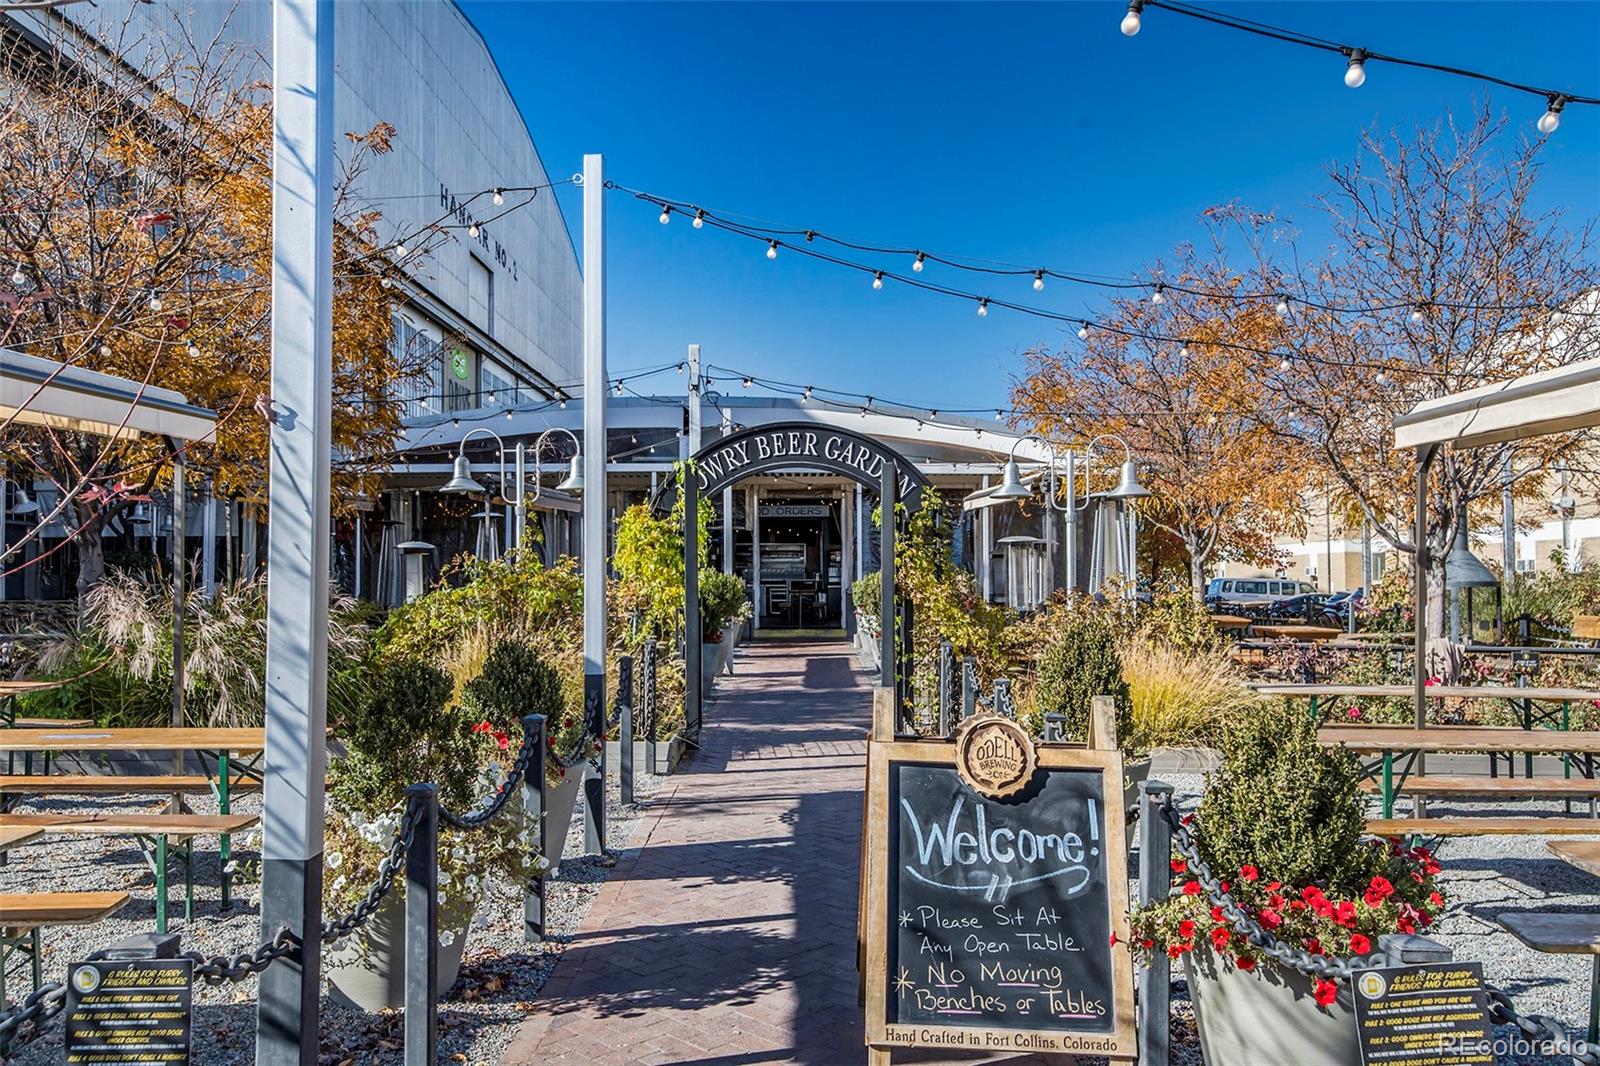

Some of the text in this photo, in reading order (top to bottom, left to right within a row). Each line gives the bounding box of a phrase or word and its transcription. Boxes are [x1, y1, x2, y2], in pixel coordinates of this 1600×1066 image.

[754, 432, 818, 459] BEER
[824, 436, 918, 499] GARDN
[776, 506, 822, 516] ORDERS
[976, 736, 1017, 762] ODELL
[979, 759, 1017, 772] BREWING
[901, 798, 1099, 866] Welcome!
[917, 905, 1062, 929] Please Sit At
[920, 932, 1085, 962] Any Open Table.
[102, 977, 188, 987] FRIENDS AND OWNERS
[141, 970, 158, 978] FOR
[158, 969, 183, 977] FURRY
[928, 961, 1063, 988] No Moving
[1389, 978, 1479, 992] FRIENDS AND OWNERS
[1402, 973, 1425, 984] RULES
[1426, 971, 1445, 981] FOR
[1445, 970, 1473, 980] FURRY
[915, 986, 1106, 1016] Benches or Tables
[1421, 998, 1434, 1006] AND
[885, 1028, 916, 1043] Hand
[921, 1029, 964, 1044] Crafted
[969, 1033, 980, 1045] in
[985, 1032, 1010, 1046] Fort
[1063, 1036, 1118, 1051] Colorado
